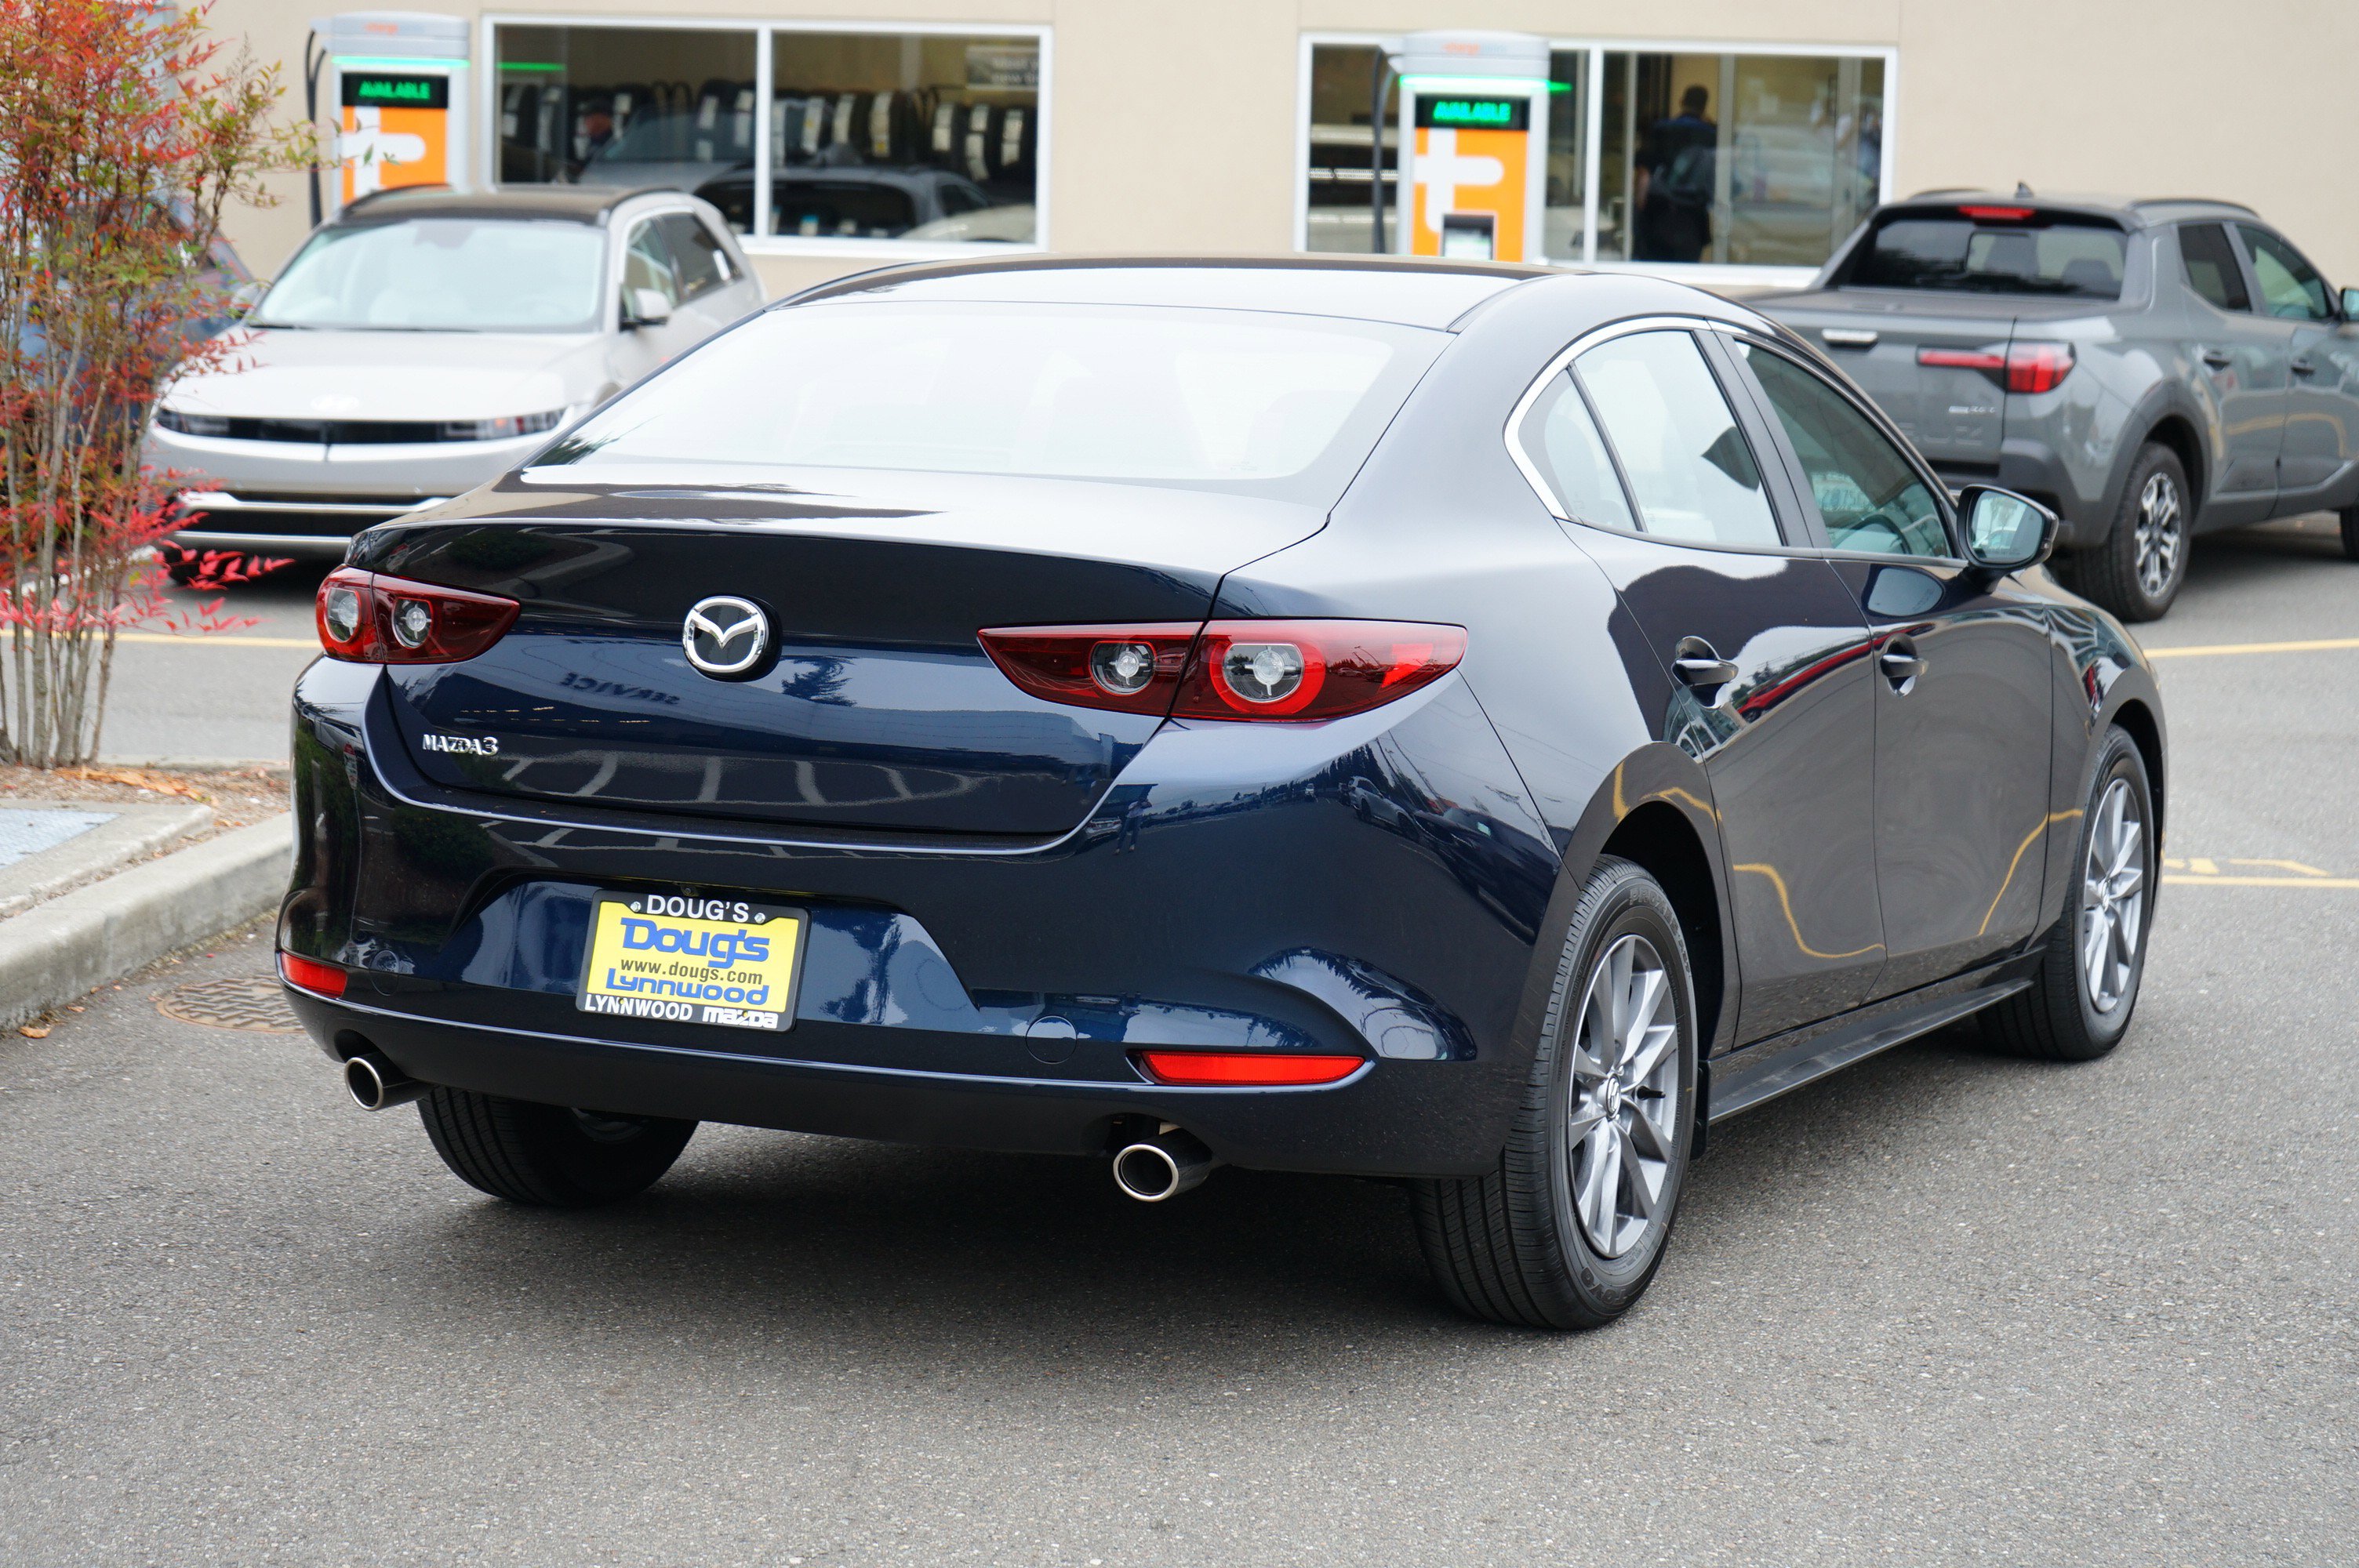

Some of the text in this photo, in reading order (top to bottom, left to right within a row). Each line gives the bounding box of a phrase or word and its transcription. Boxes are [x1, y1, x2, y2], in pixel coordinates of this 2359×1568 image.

[358, 80, 431, 100] AVAILABLE
[1433, 101, 1511, 122] AVAILABLE
[422, 734, 499, 757] MAZDA3
[646, 895, 750, 923] DOUG'S
[620, 917, 770, 969] Doug's
[620, 959, 763, 985] www.dougs.com
[605, 968, 770, 1006] Lynnwood
[584, 993, 693, 1022] LYNNWOOD
